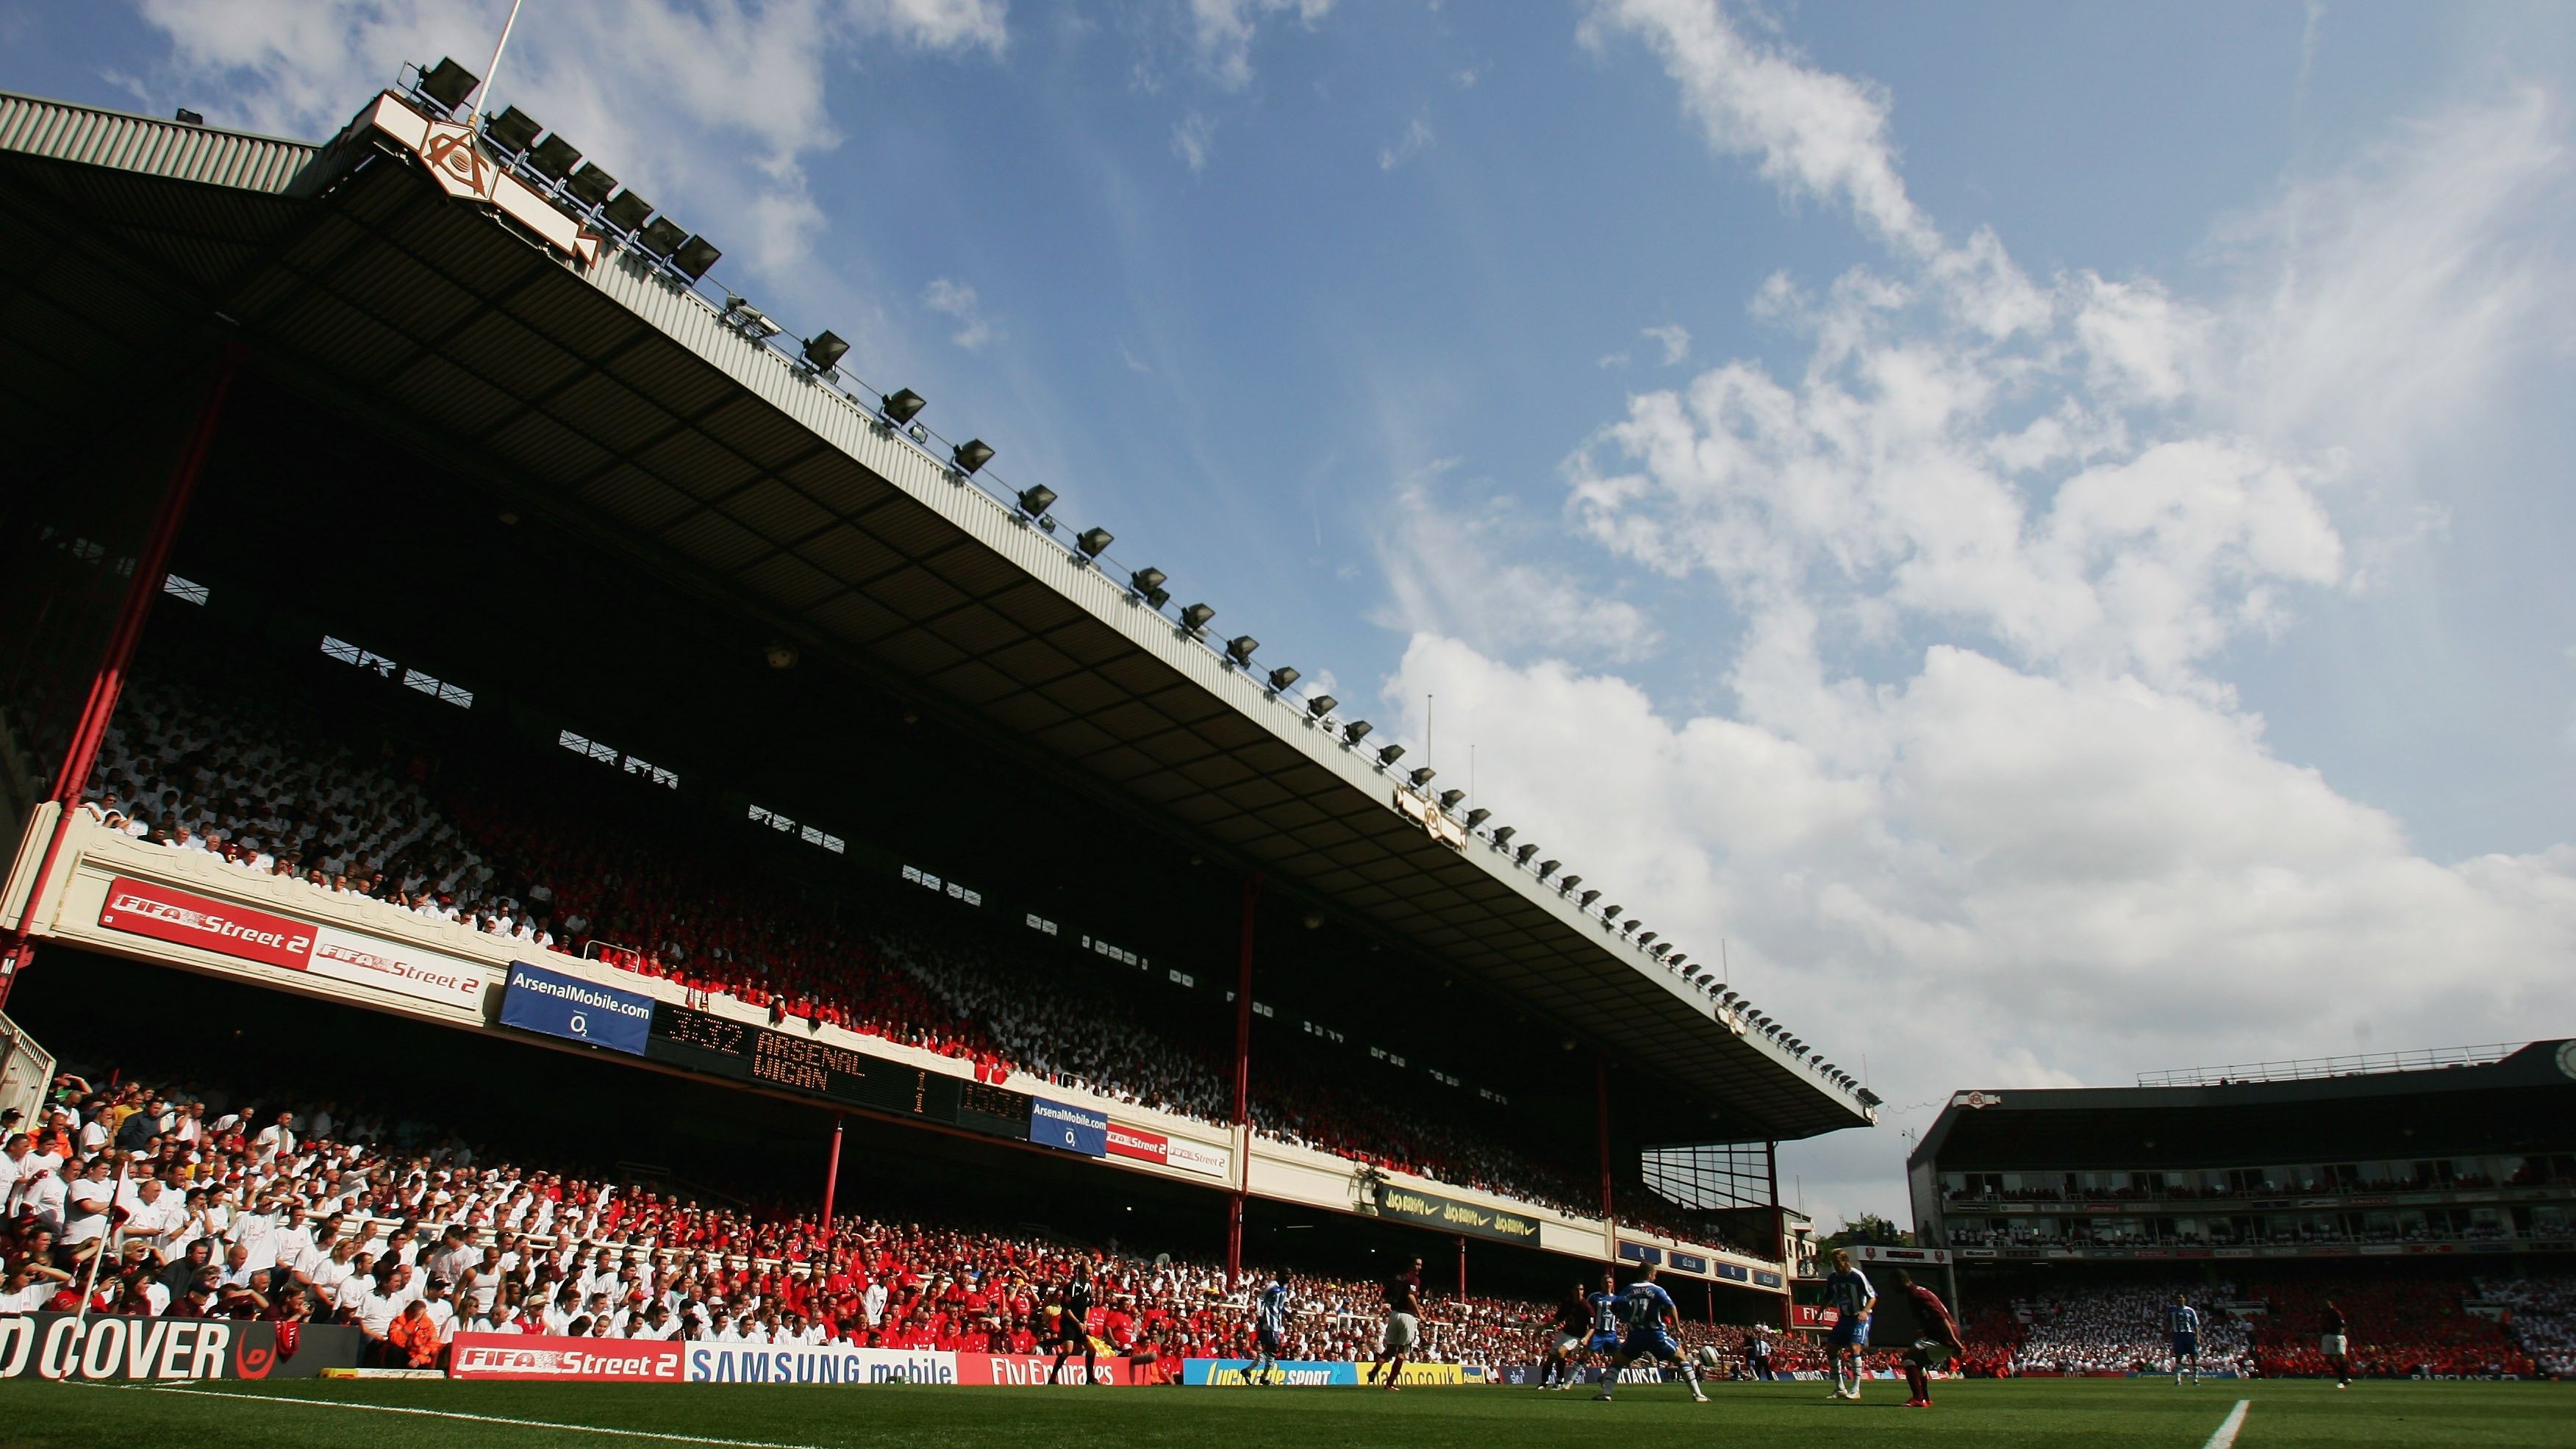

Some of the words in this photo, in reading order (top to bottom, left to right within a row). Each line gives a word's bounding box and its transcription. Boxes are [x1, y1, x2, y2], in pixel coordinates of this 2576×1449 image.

[116, 894, 181, 920] FIFA
[201, 915, 285, 949] Street
[286, 934, 311, 954] 2
[1, 958, 15, 975] M
[318, 944, 374, 967] FIFA
[391, 960, 459, 990] Street
[459, 977, 480, 995] 2
[512, 972, 650, 1020] ArsenalMobile.com
[670, 1009, 743, 1055] 3:32
[756, 1031, 866, 1077] ARSENAL
[754, 1054, 828, 1091] WIGAN
[1034, 1103, 1106, 1131] ArsenalMobile.com
[1131, 1137, 1159, 1153] Street
[1159, 1143, 1167, 1155] 2
[1195, 1153, 1218, 1167] Street
[1219, 1159, 1226, 1167] 2
[1628, 1298, 1649, 1323] 27
[40, 1317, 231, 1378] COVER
[465, 1350, 536, 1368] FIFA
[561, 1351, 651, 1375] Street
[656, 1353, 678, 1376] 2
[693, 1348, 859, 1384] SAMSUNG
[870, 1357, 952, 1384] mobile
[990, 1358, 1026, 1385] Fly
[1028, 1359, 1114, 1386] Emiraes
[1600, 1368, 1649, 1384] CLAYS
[1287, 1370, 1331, 1385] SPORT
